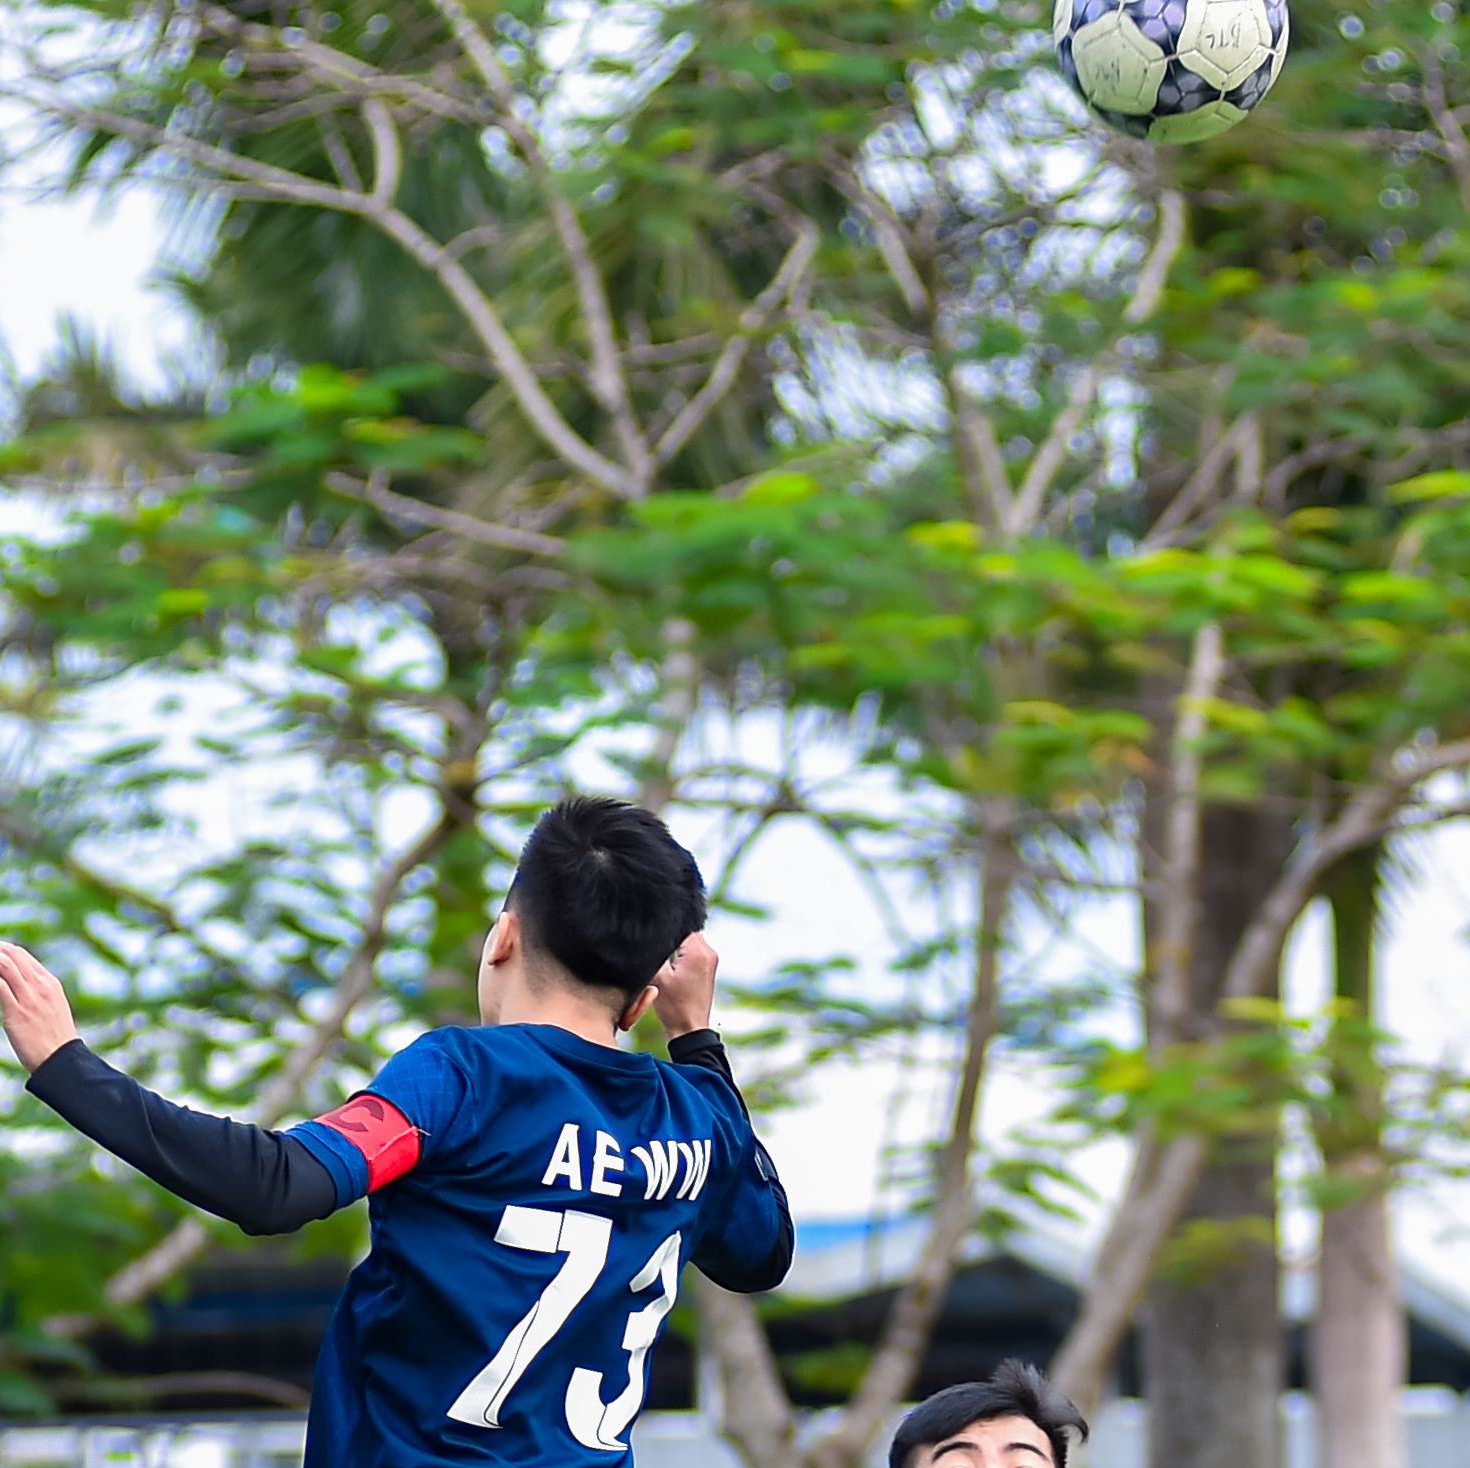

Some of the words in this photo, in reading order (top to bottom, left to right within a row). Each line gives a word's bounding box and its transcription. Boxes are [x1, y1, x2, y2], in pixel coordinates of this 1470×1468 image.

[326, 1099, 385, 1132] C
[541, 1123, 625, 1197] AE
[447, 1205, 682, 1451] 73
